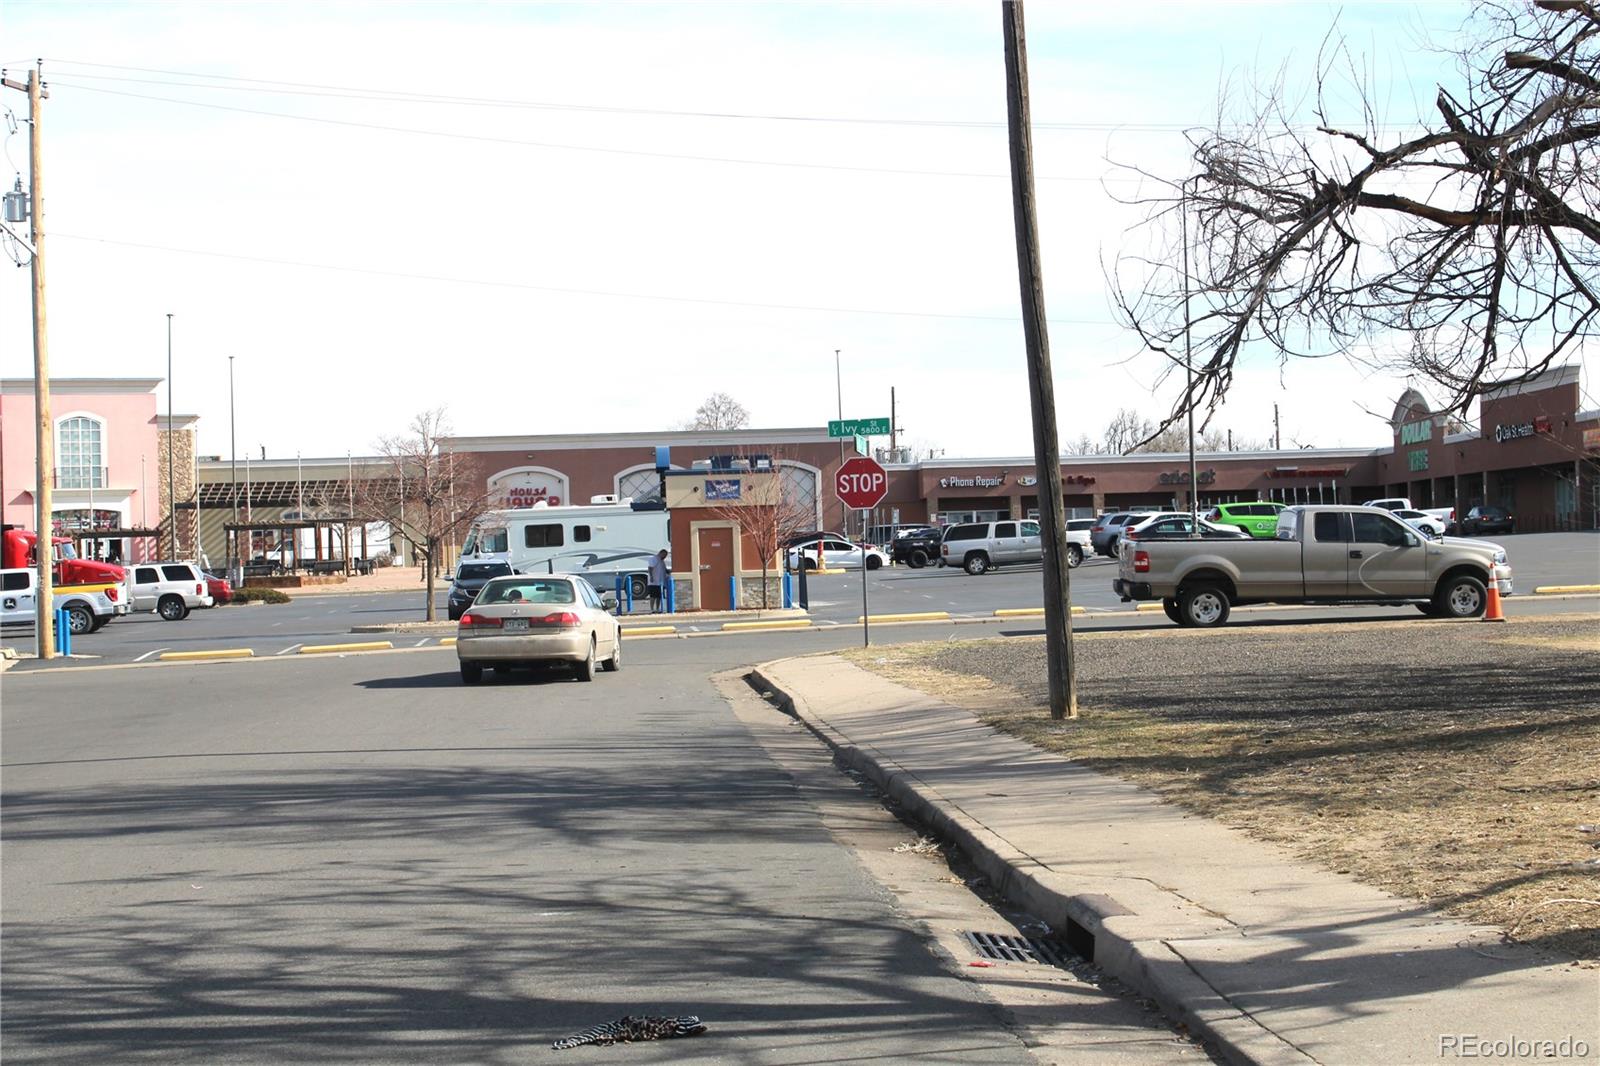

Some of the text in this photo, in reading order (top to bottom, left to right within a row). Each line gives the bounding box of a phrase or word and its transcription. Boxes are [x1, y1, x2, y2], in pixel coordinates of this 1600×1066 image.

[841, 422, 857, 435] Ivy
[861, 425, 887, 434] 5800 E
[1401, 420, 1432, 445] DOLLAR
[839, 473, 883, 493] STOP
[950, 475, 1001, 488] Phone Repair
